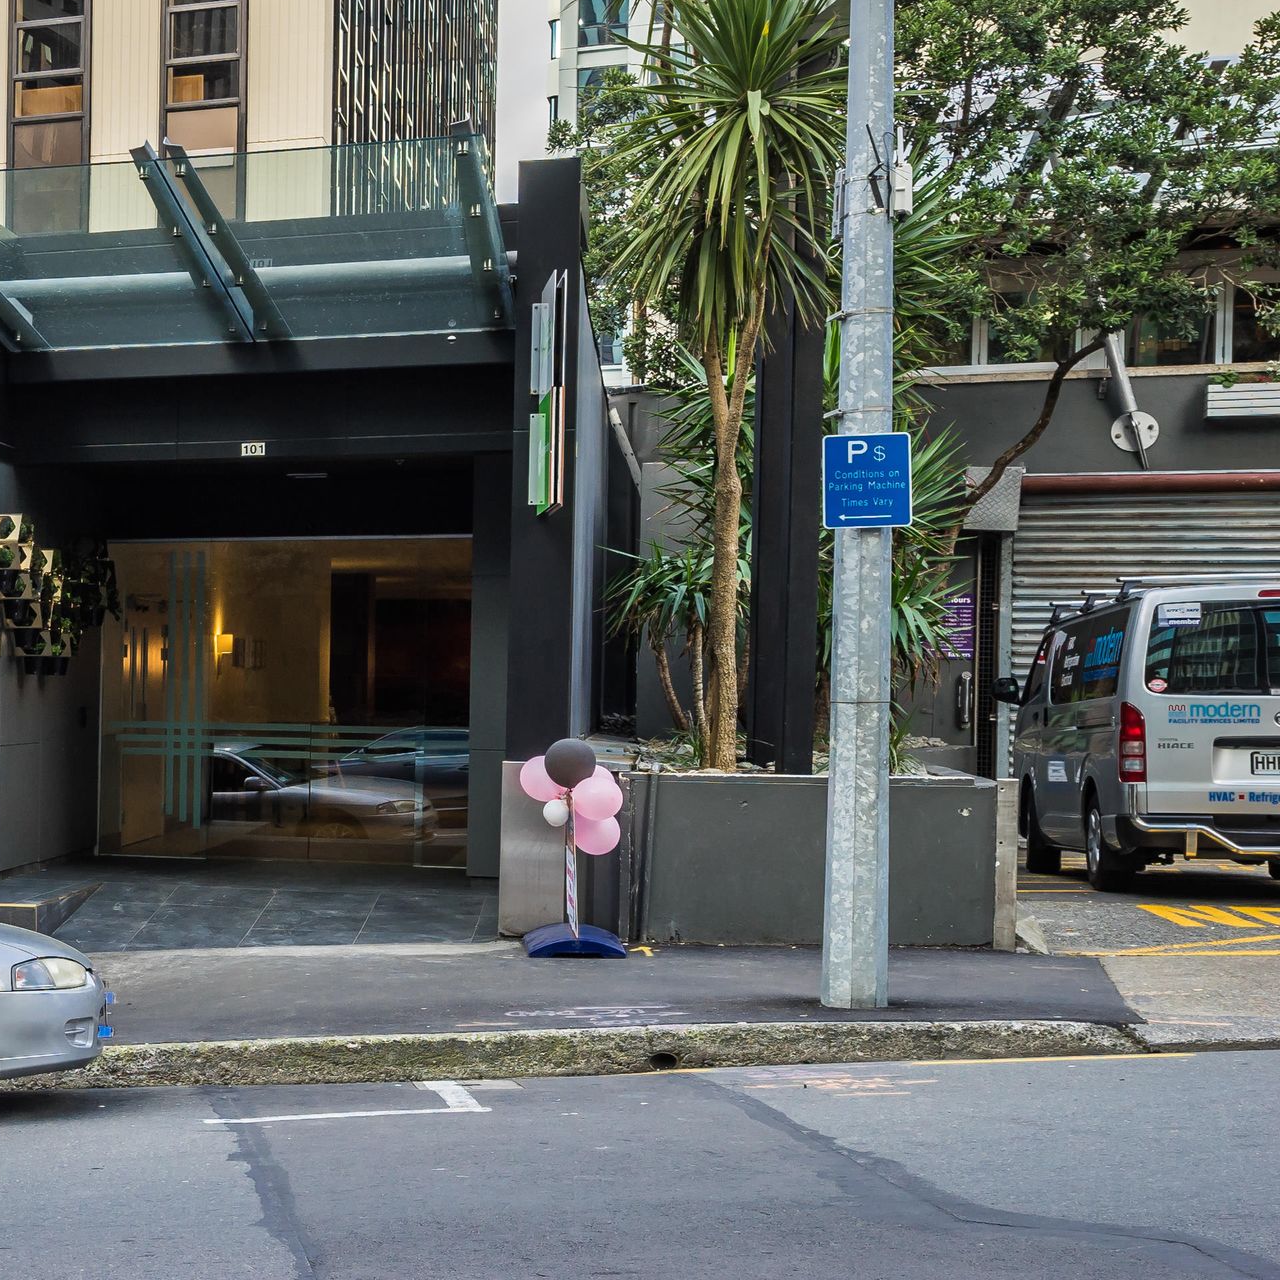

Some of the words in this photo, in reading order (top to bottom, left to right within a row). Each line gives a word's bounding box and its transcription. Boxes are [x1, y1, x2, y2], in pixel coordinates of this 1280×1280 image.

[243, 444, 265, 455] 101
[847, 440, 868, 464] P
[873, 445, 886, 462] $
[834, 470, 885, 480] Conditions
[888, 470, 900, 478] on
[828, 482, 863, 492] Parking
[867, 480, 906, 490] Machine
[841, 498, 869, 507] Times
[872, 497, 894, 508] Vary
[1189, 701, 1261, 718] modern
[1254, 756, 1280, 770] HH
[1208, 791, 1235, 802] HVAC
